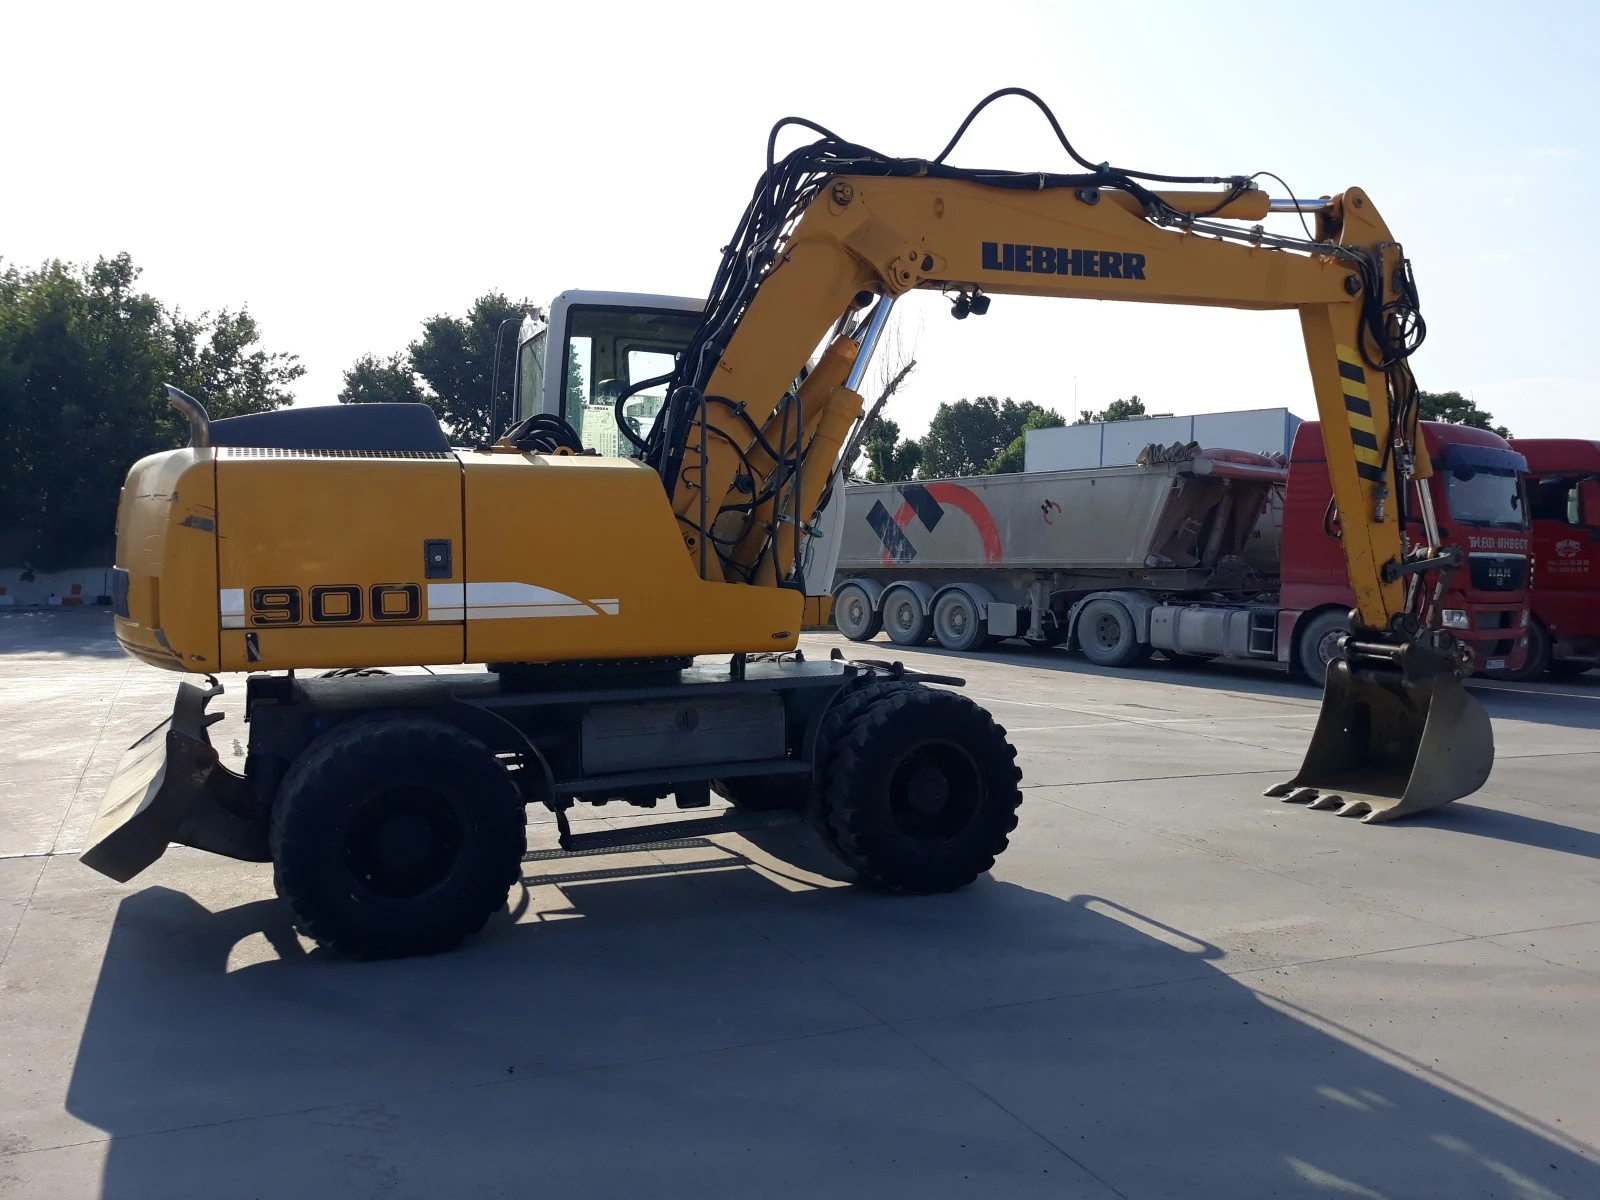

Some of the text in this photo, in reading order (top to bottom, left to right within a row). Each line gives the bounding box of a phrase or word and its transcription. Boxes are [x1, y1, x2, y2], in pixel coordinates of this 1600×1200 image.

[982, 242, 1146, 280] LIEBHERR
[1497, 537, 1529, 550] ИНВЕСТ
[1488, 568, 1511, 577] MAN
[251, 583, 422, 627] 900
